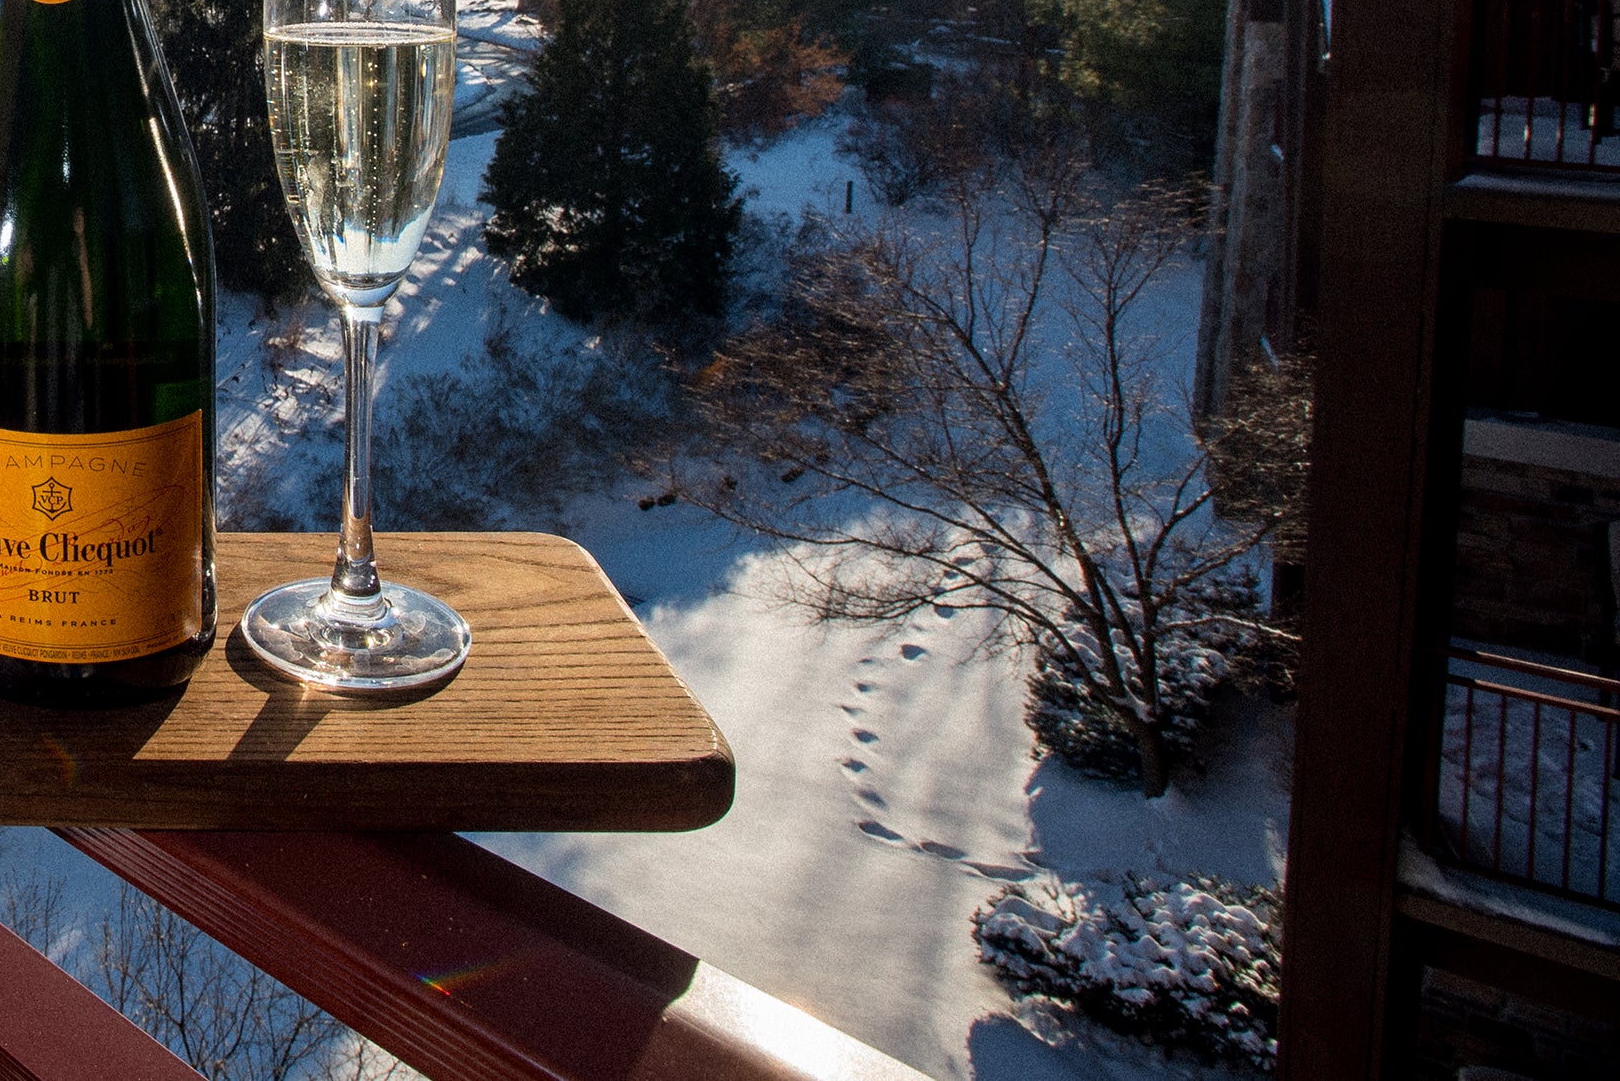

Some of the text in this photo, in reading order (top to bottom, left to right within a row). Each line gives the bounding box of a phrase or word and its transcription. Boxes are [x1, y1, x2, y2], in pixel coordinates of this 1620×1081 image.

[40, 494, 64, 506] VCP
[39, 528, 157, 567] Clicquot
[28, 588, 81, 605] BRUT
[9, 615, 53, 627] REIMS
[61, 618, 118, 627] FRANCE
